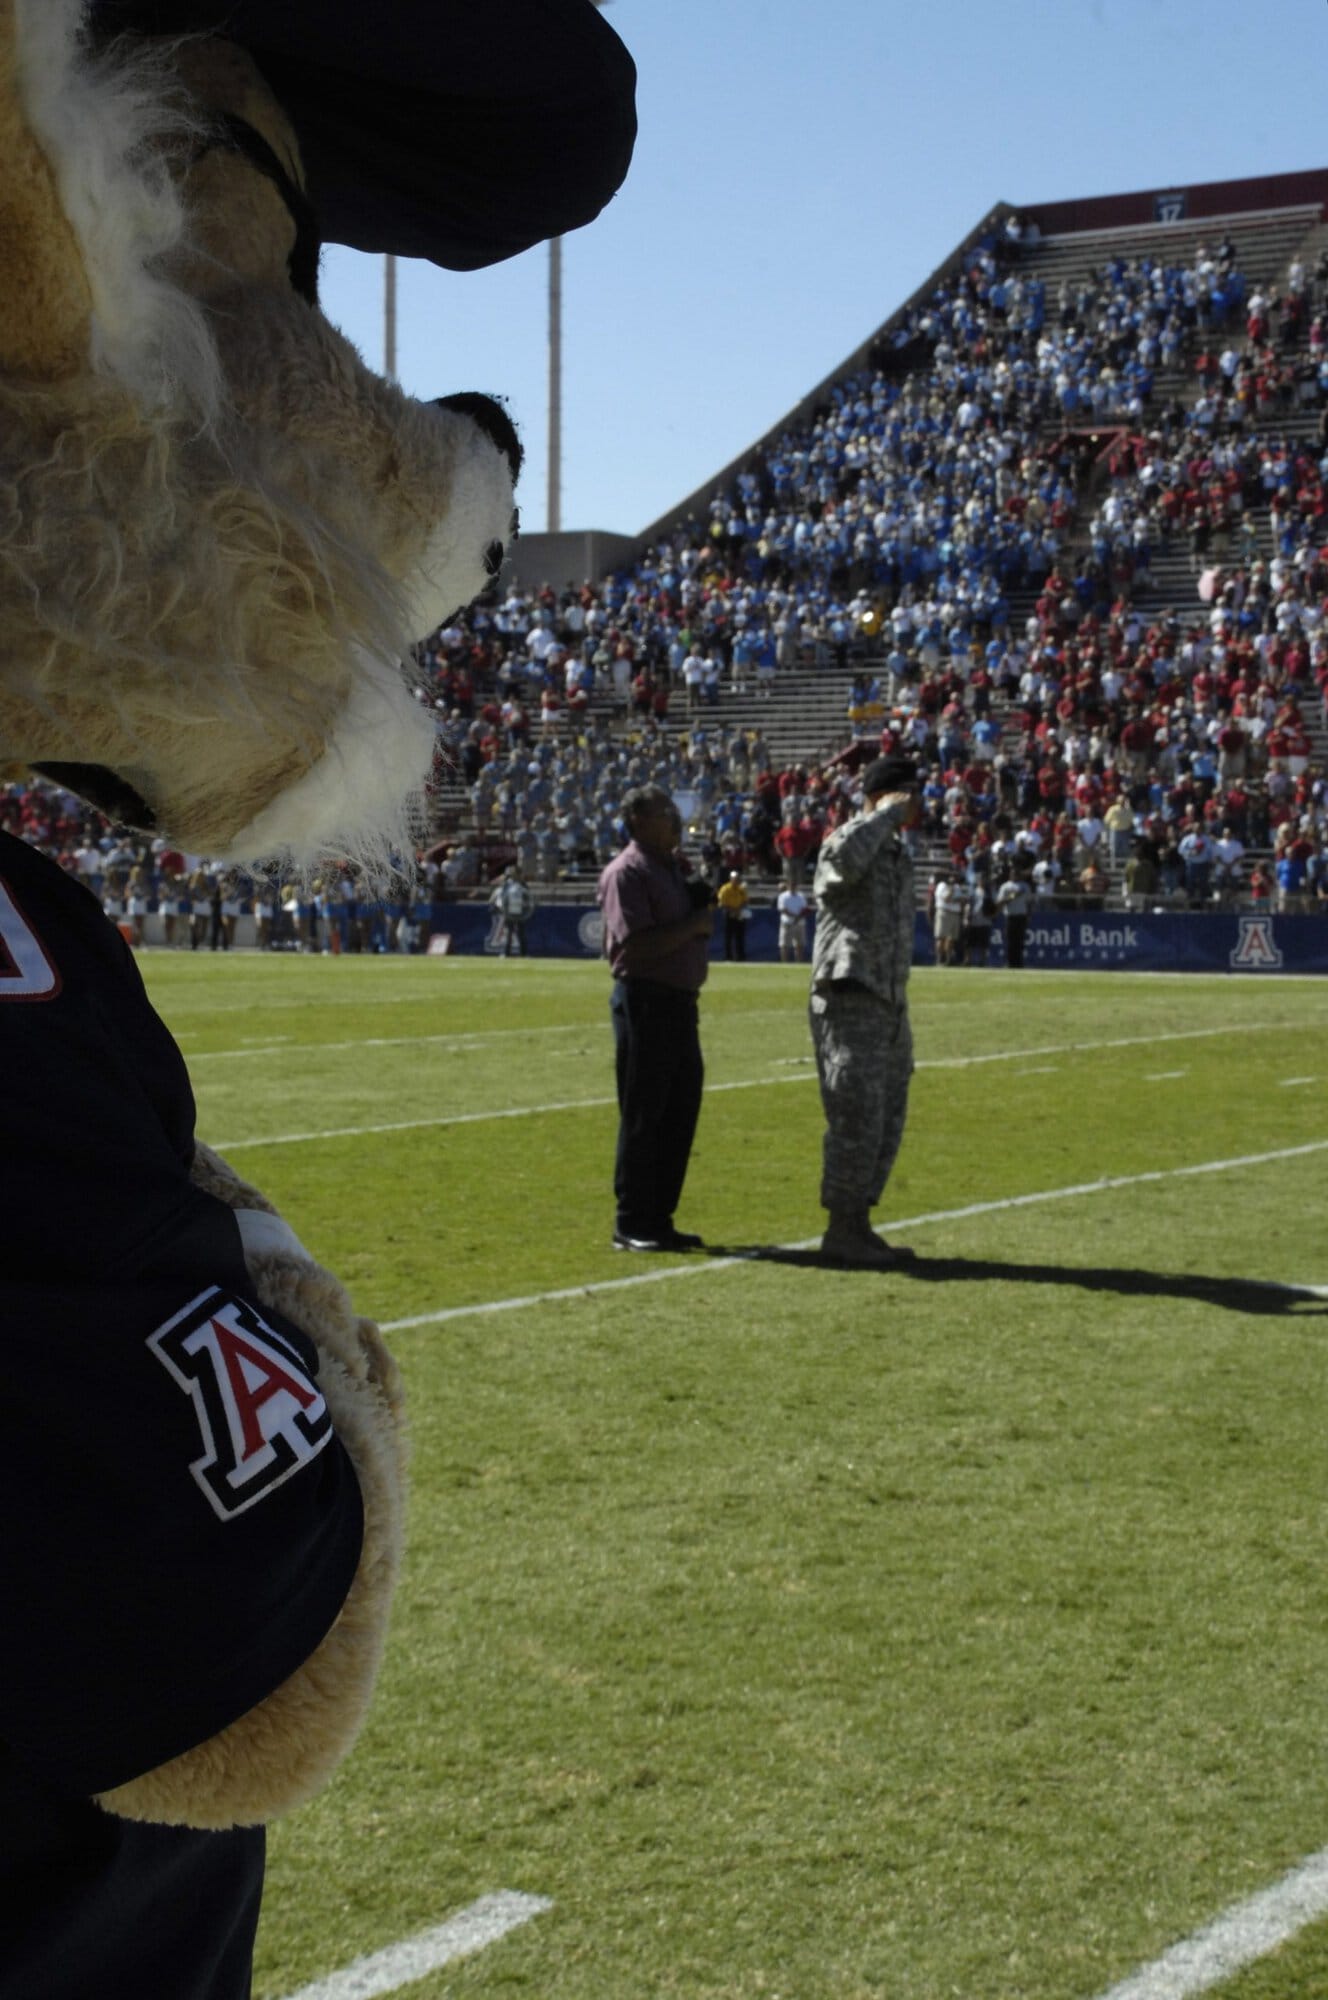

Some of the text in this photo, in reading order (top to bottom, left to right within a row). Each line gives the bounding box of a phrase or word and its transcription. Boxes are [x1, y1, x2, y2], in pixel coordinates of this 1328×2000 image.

[1159, 203, 1182, 225] 17
[988, 923, 1138, 947] aonal Bank
[1229, 916, 1284, 968] A
[145, 1284, 333, 1522] A
